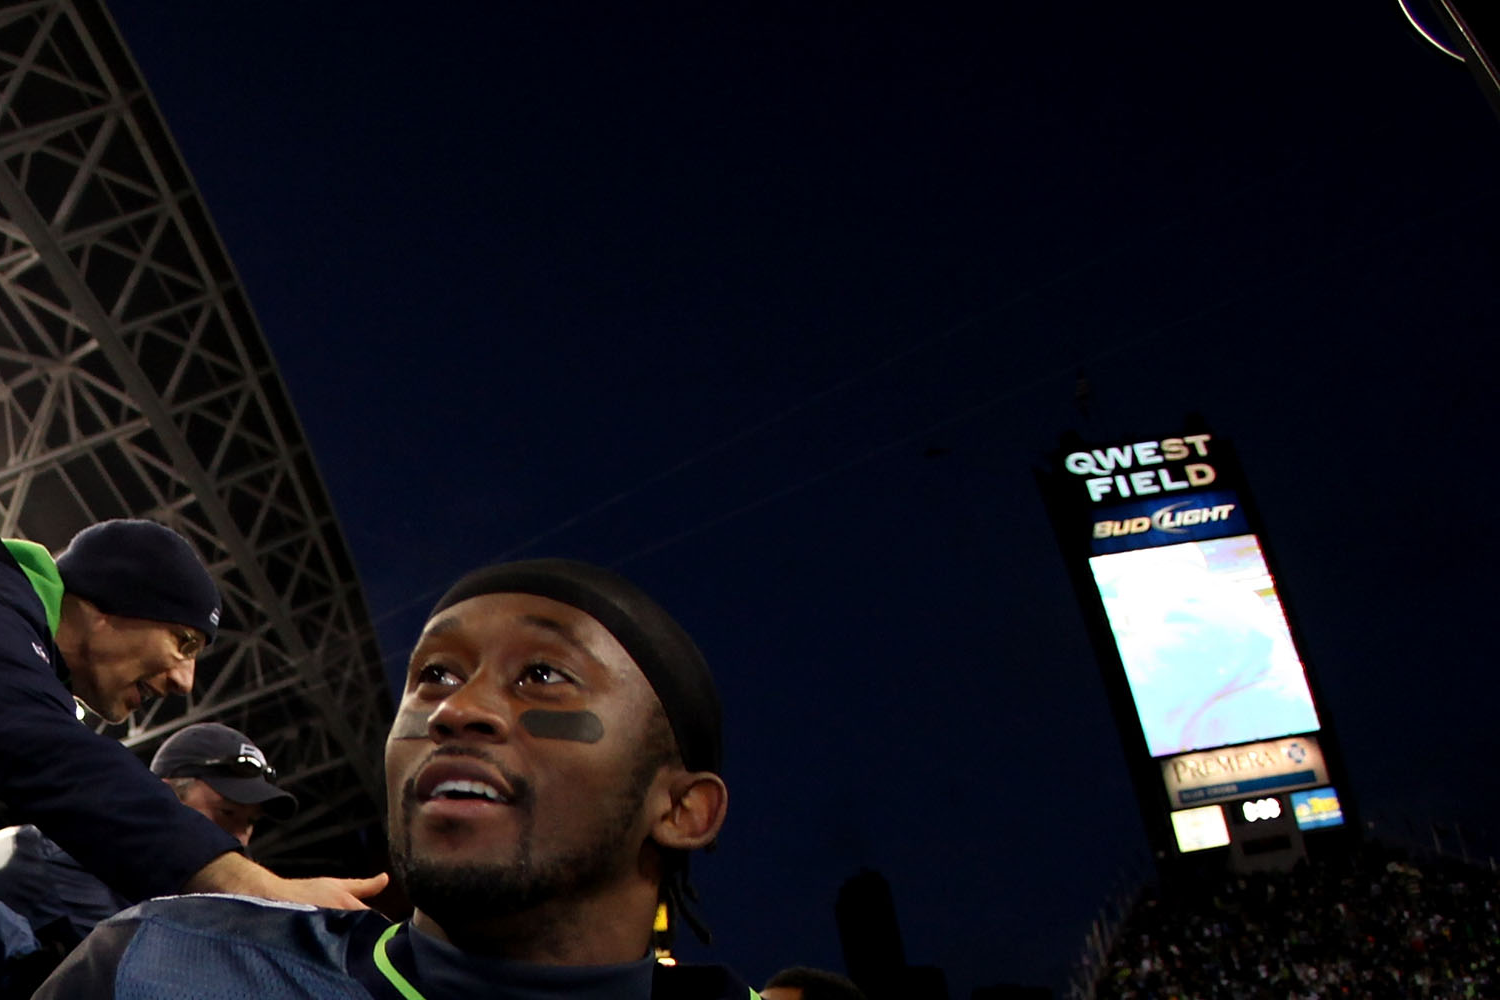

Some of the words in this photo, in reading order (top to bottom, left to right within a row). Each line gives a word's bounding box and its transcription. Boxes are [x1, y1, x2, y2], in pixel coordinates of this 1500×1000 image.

[1064, 434, 1211, 476] QWEST
[1085, 463, 1216, 502] FIELD
[1093, 516, 1151, 539] BUD
[1161, 504, 1235, 529] LIGHT
